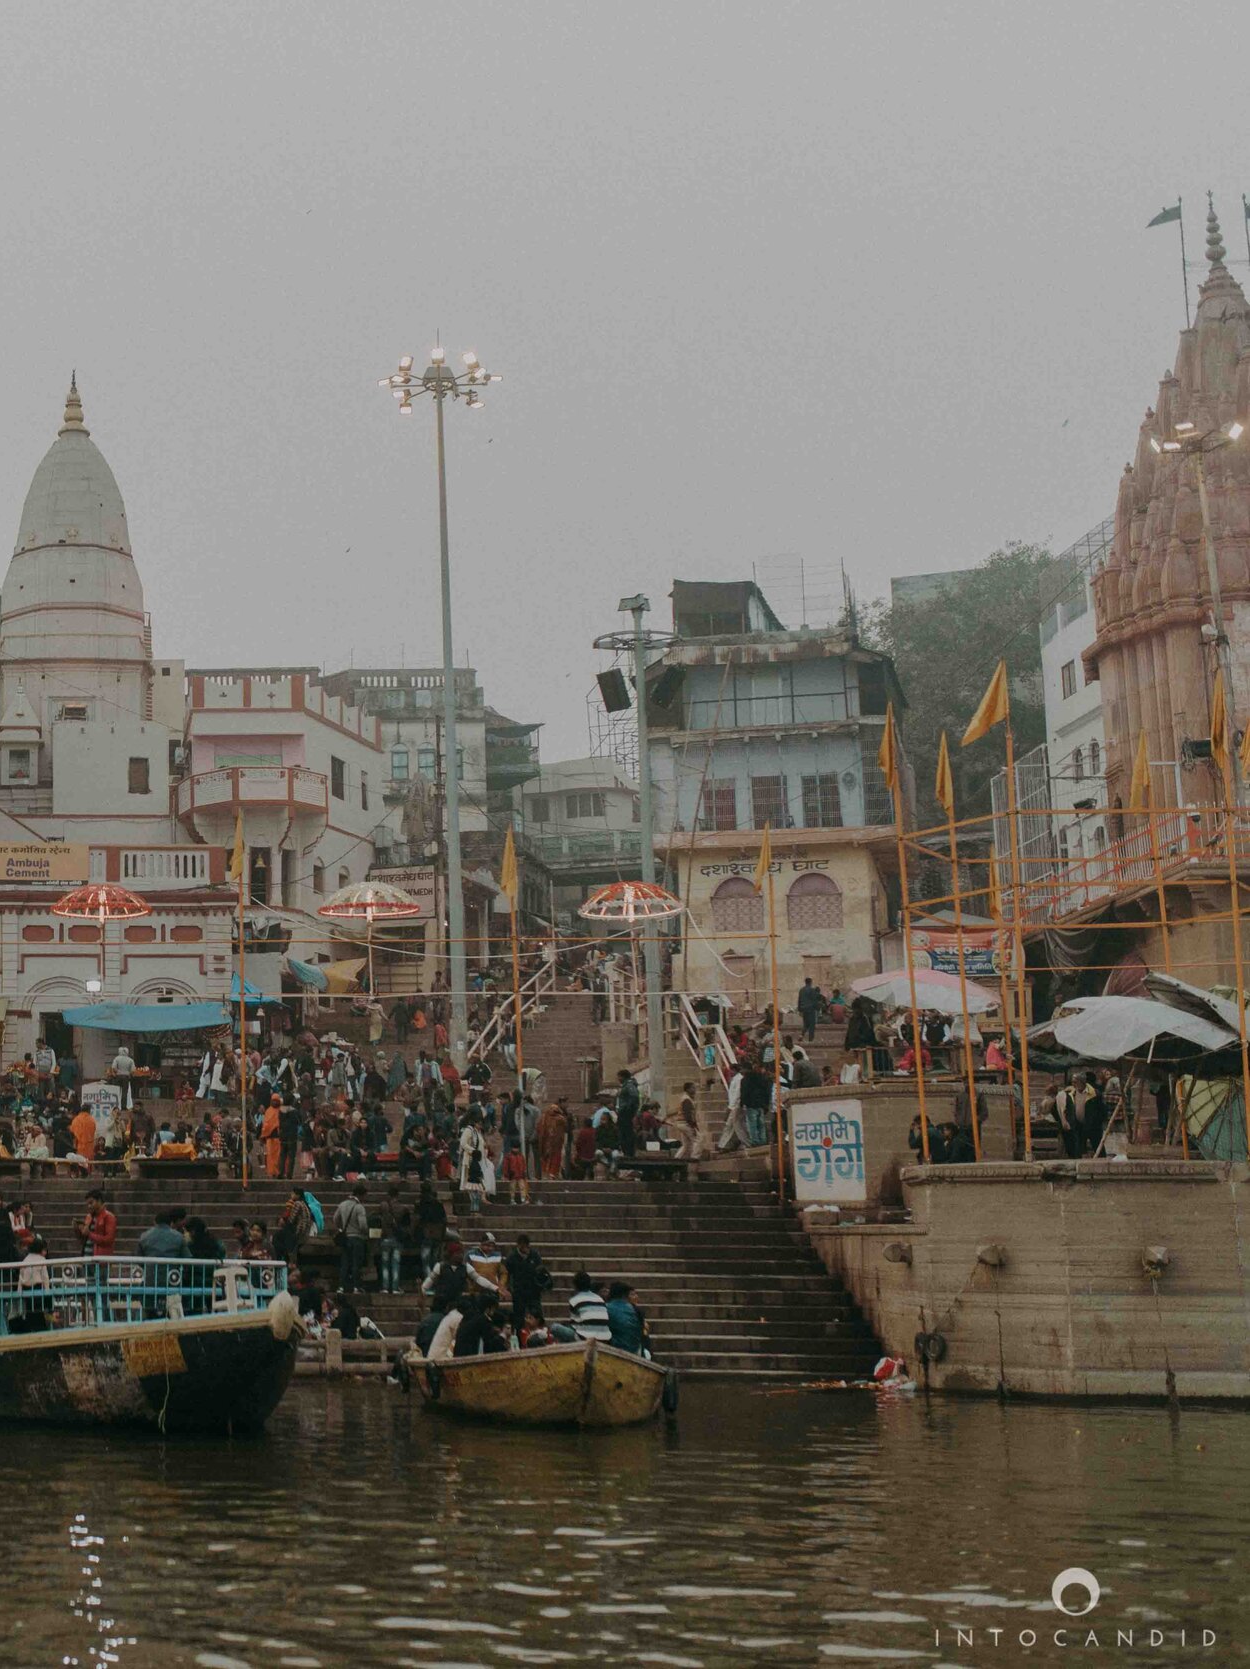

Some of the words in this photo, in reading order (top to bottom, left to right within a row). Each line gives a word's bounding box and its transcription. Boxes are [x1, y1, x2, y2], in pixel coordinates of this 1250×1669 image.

[6, 857, 50, 869] Ambuja
[700, 861, 783, 877] दशाश्वध
[792, 859, 830, 872] घाट
[5, 868, 50, 877] Cement
[417, 872, 434, 880] घाट
[795, 1112, 850, 1142] नमामि
